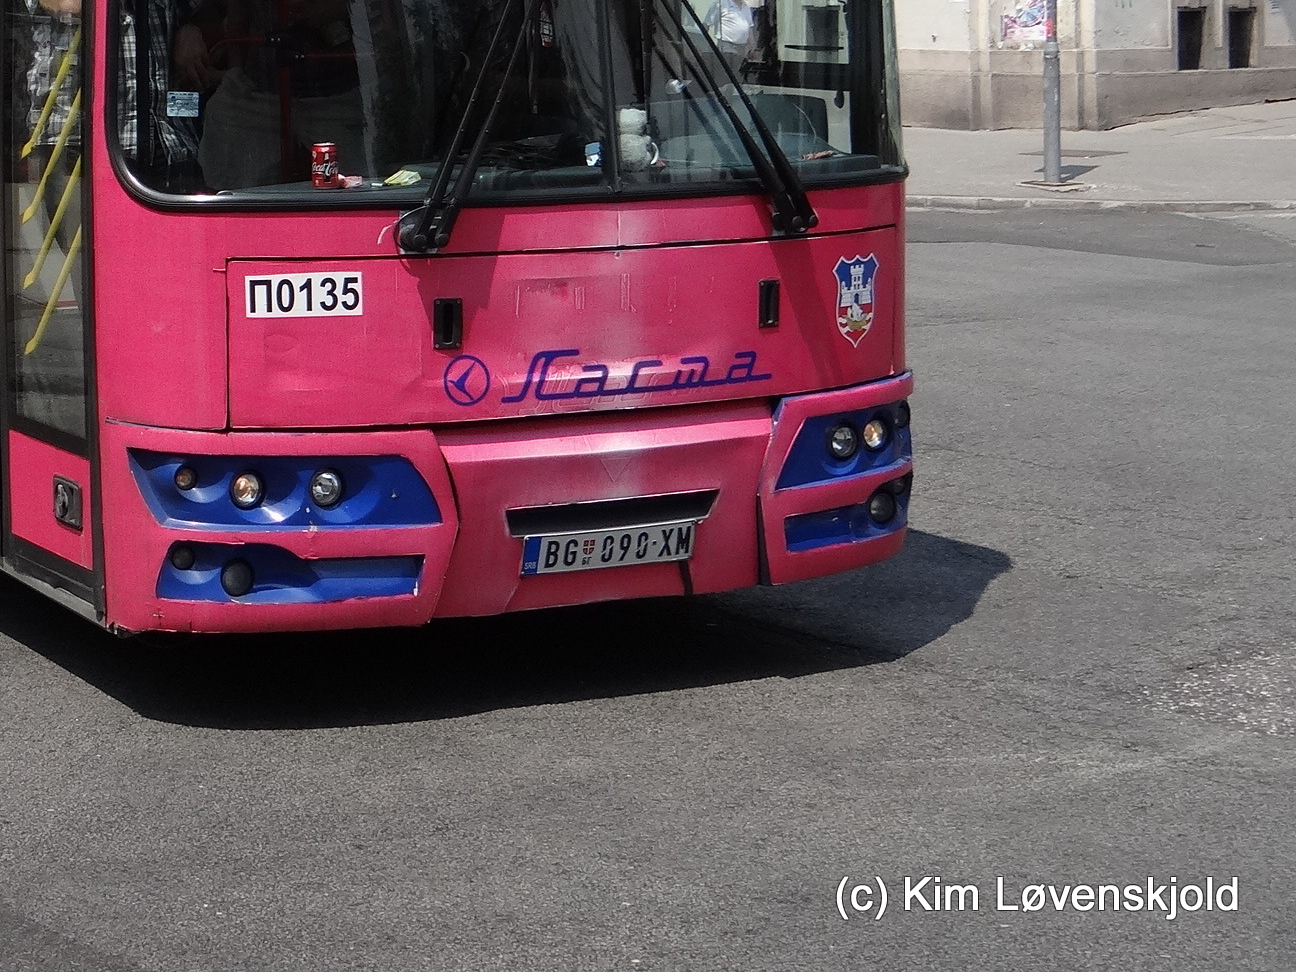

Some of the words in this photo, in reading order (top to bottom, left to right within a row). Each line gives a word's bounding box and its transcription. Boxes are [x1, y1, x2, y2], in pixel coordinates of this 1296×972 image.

[249, 277, 360, 313] П0135
[524, 561, 537, 570] SRB
[544, 538, 579, 569] BG
